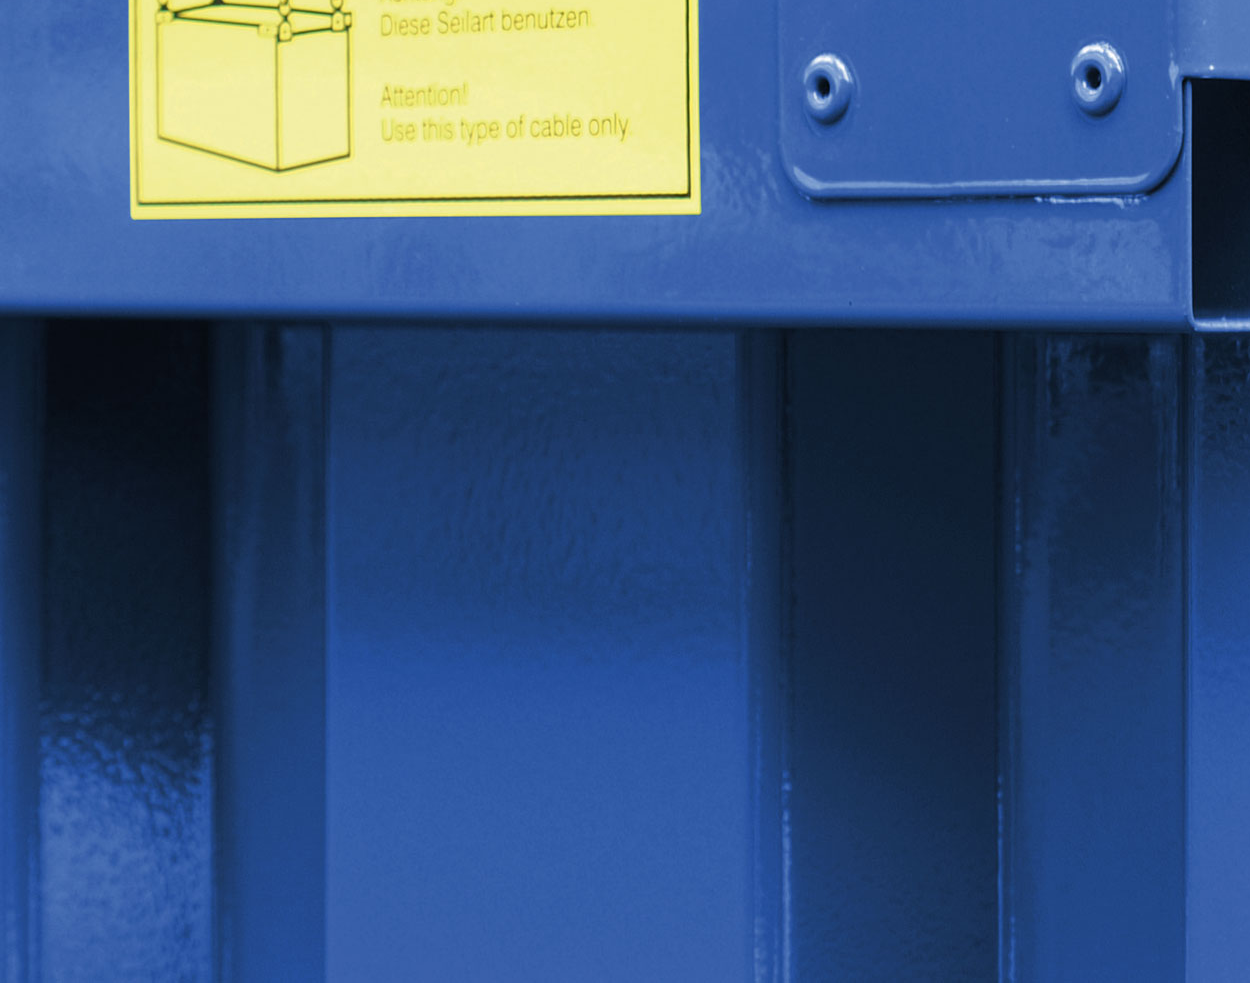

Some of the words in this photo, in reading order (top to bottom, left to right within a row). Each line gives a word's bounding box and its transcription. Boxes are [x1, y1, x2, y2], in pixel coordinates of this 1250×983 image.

[381, 13, 431, 37] Diese
[436, 10, 496, 35] Seilart
[380, 82, 468, 108] Attention!
[381, 118, 416, 142] Use
[423, 115, 454, 141] this
[461, 119, 499, 146] type
[506, 113, 526, 139] of
[530, 112, 583, 138] cable
